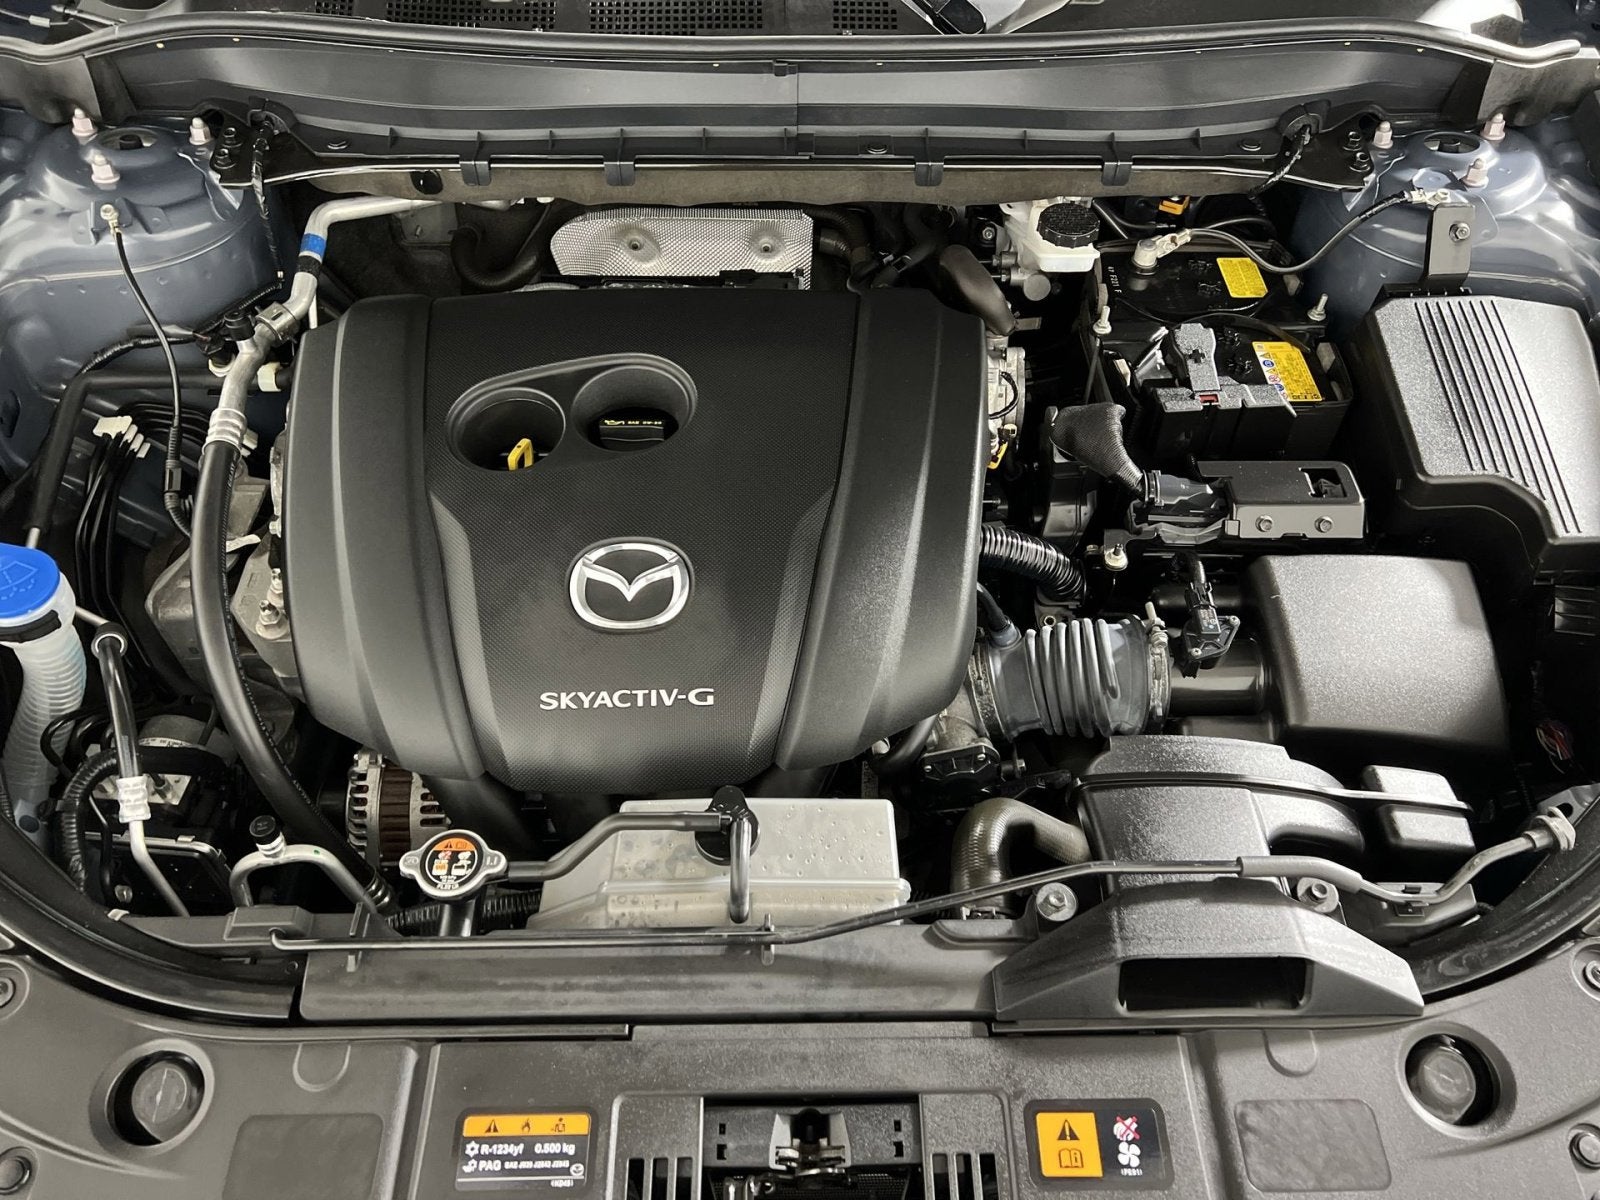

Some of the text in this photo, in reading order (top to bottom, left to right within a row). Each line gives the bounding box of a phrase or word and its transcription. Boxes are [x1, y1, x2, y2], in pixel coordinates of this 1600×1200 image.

[539, 688, 714, 710] SKYACTIV-G
[480, 1143, 576, 1157] R-1234yf 0.500 kg
